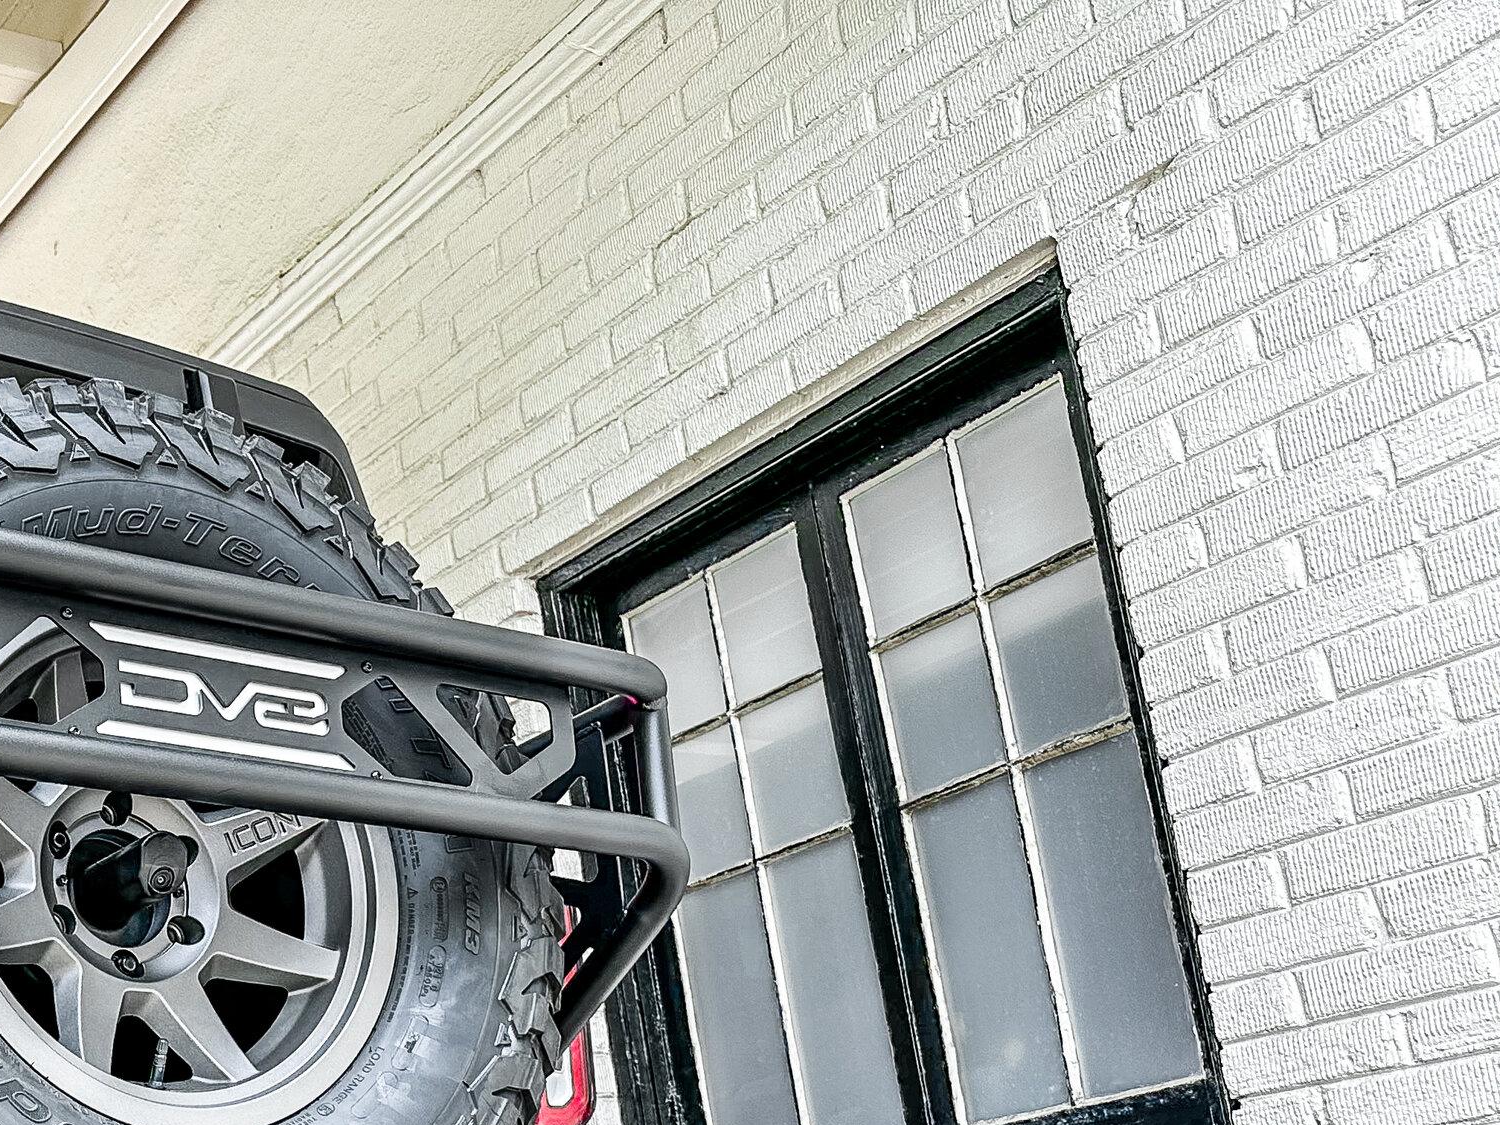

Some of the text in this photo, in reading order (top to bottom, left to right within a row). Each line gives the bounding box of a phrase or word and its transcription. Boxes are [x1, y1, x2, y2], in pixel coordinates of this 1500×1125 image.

[21, 503, 320, 590] Mud-Ter
[223, 811, 302, 856] ICON
[362, 1045, 385, 1074] LOAD
[332, 1074, 365, 1105] RANGE
